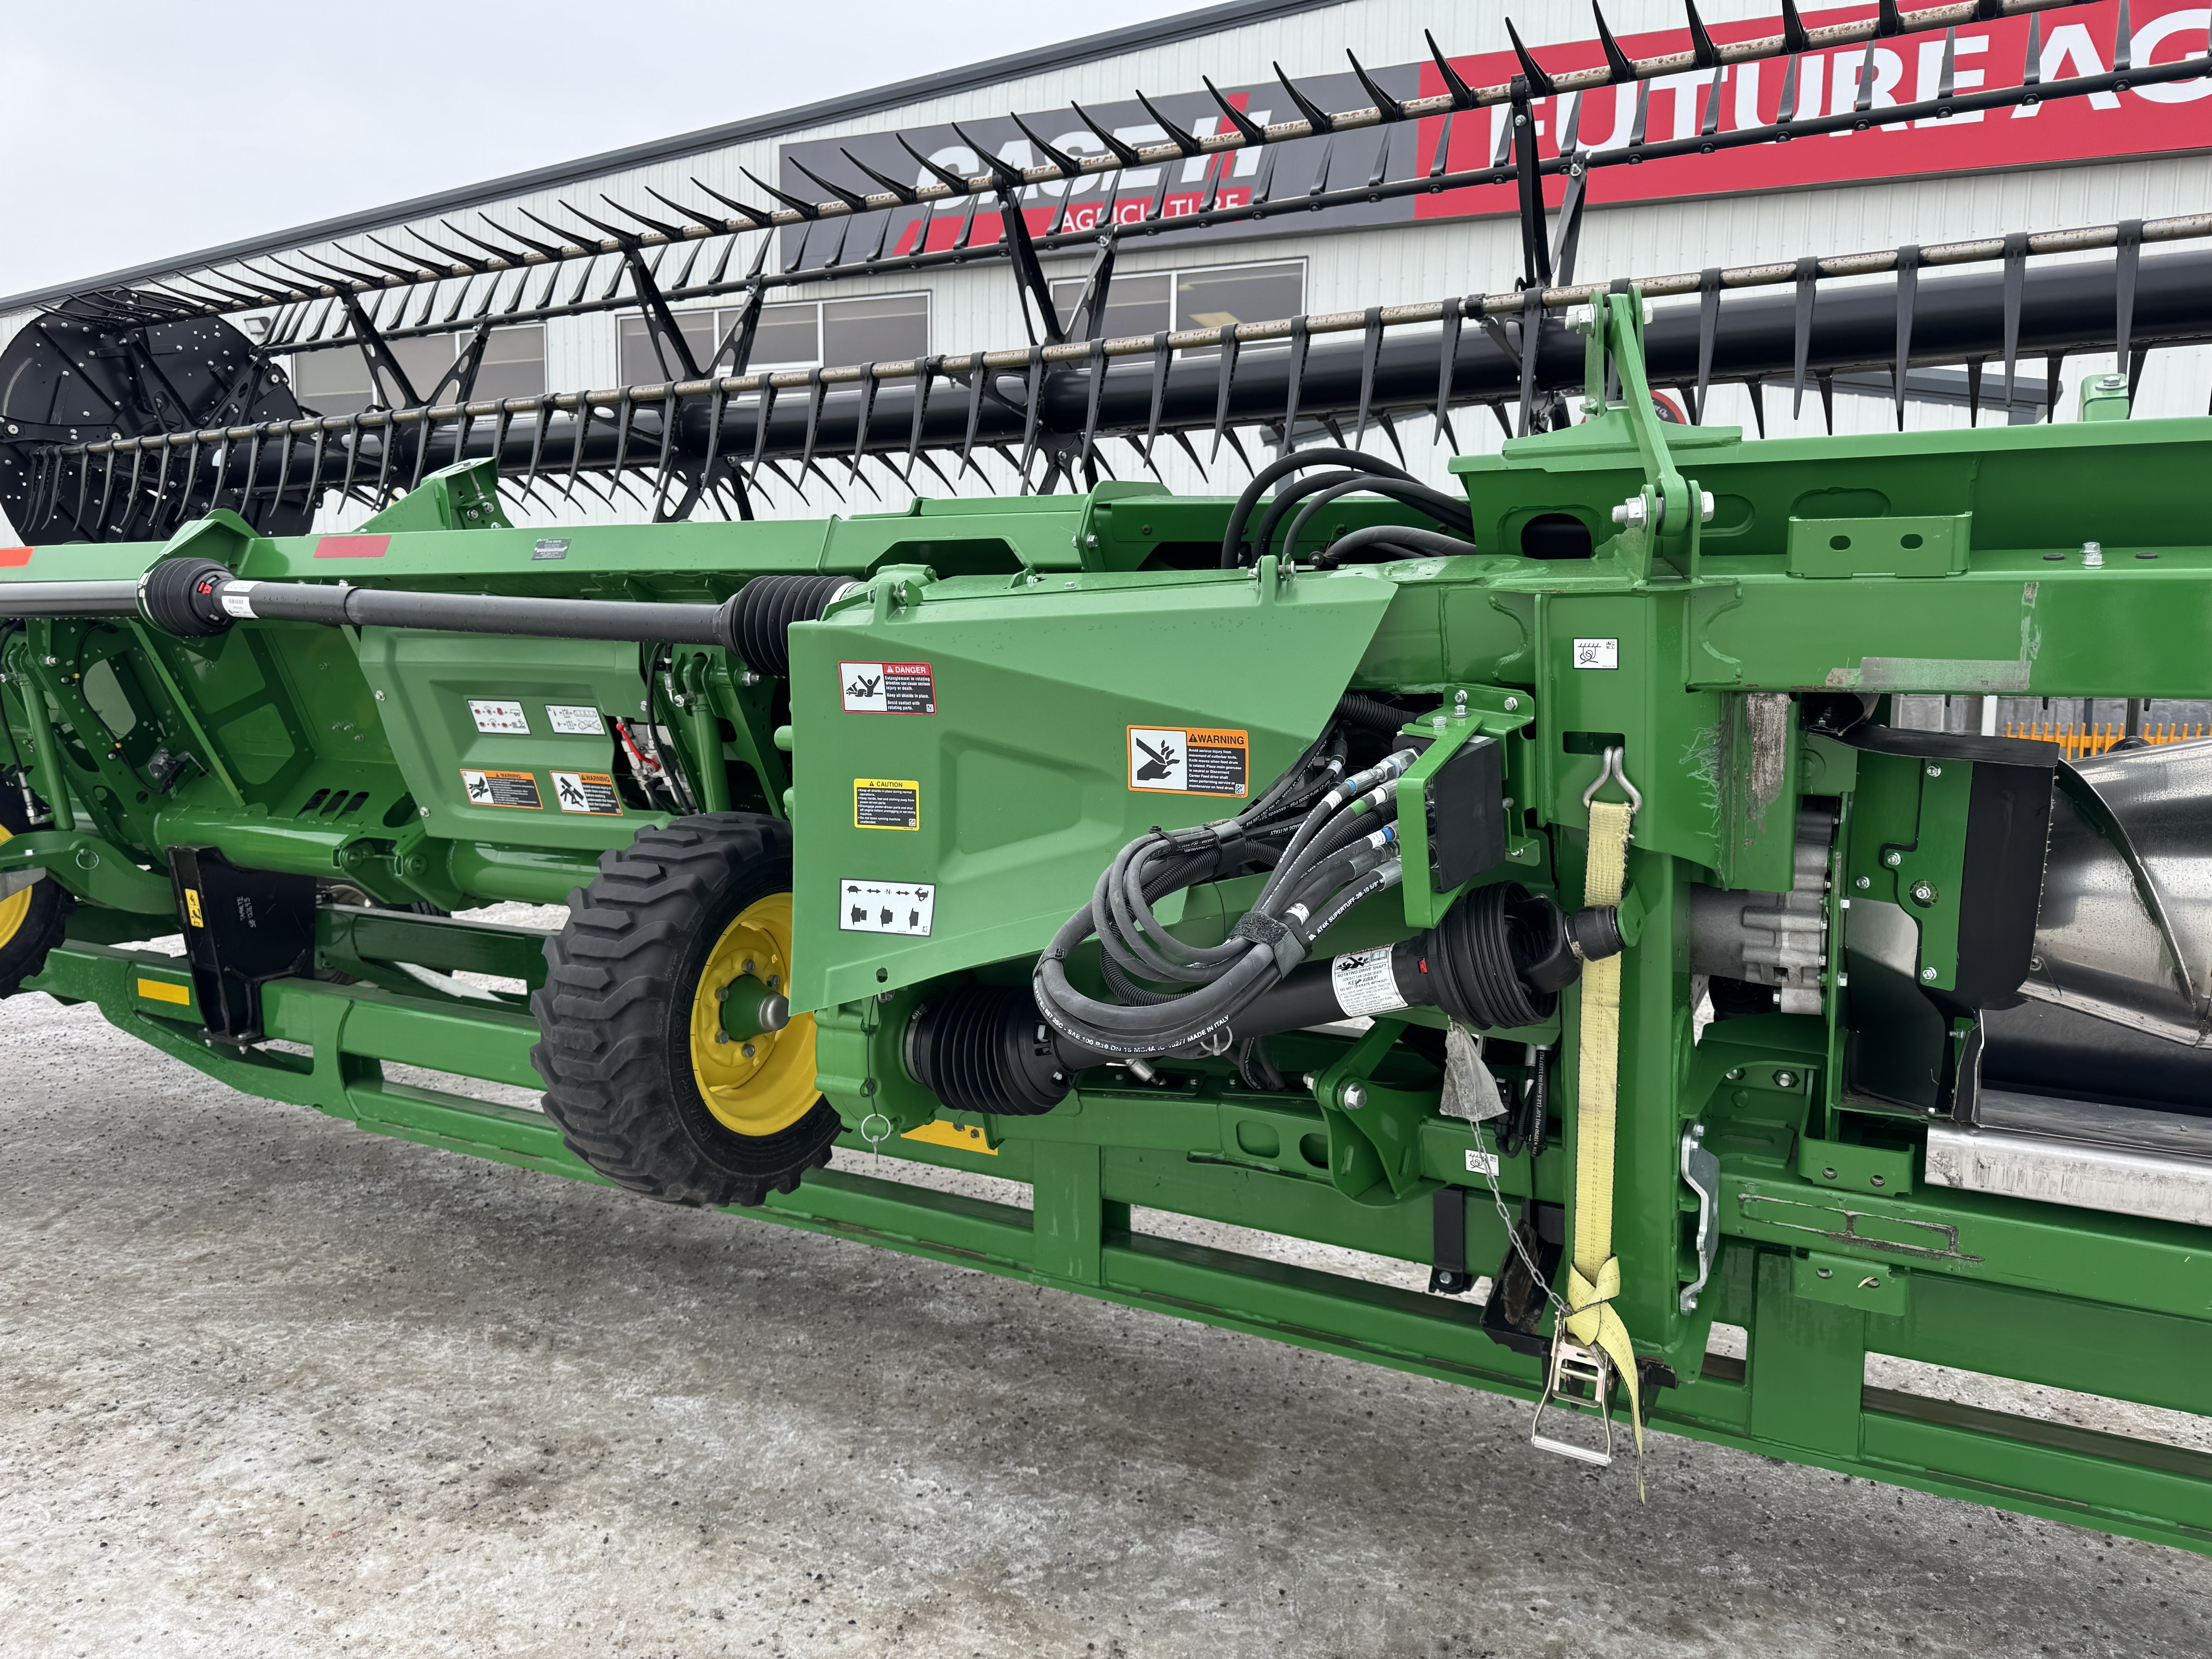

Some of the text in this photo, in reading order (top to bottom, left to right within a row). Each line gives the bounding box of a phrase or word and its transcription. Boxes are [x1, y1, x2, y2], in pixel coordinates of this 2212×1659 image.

[917, 124, 1168, 210] CASE
[1198, 734, 1244, 745] WARNING
[1317, 921, 1329, 934] AT4K
[1328, 886, 1369, 923] SUPERTUFF-2B-10
[674, 963, 713, 1142] CARLISLE
[1052, 1017, 1064, 1029] 2SC
[1067, 1029, 1080, 1040] SAE
[1082, 1037, 1094, 1045] 100
[1187, 1030, 1206, 1042] MADE
[1214, 1015, 1229, 1029] ITALY
